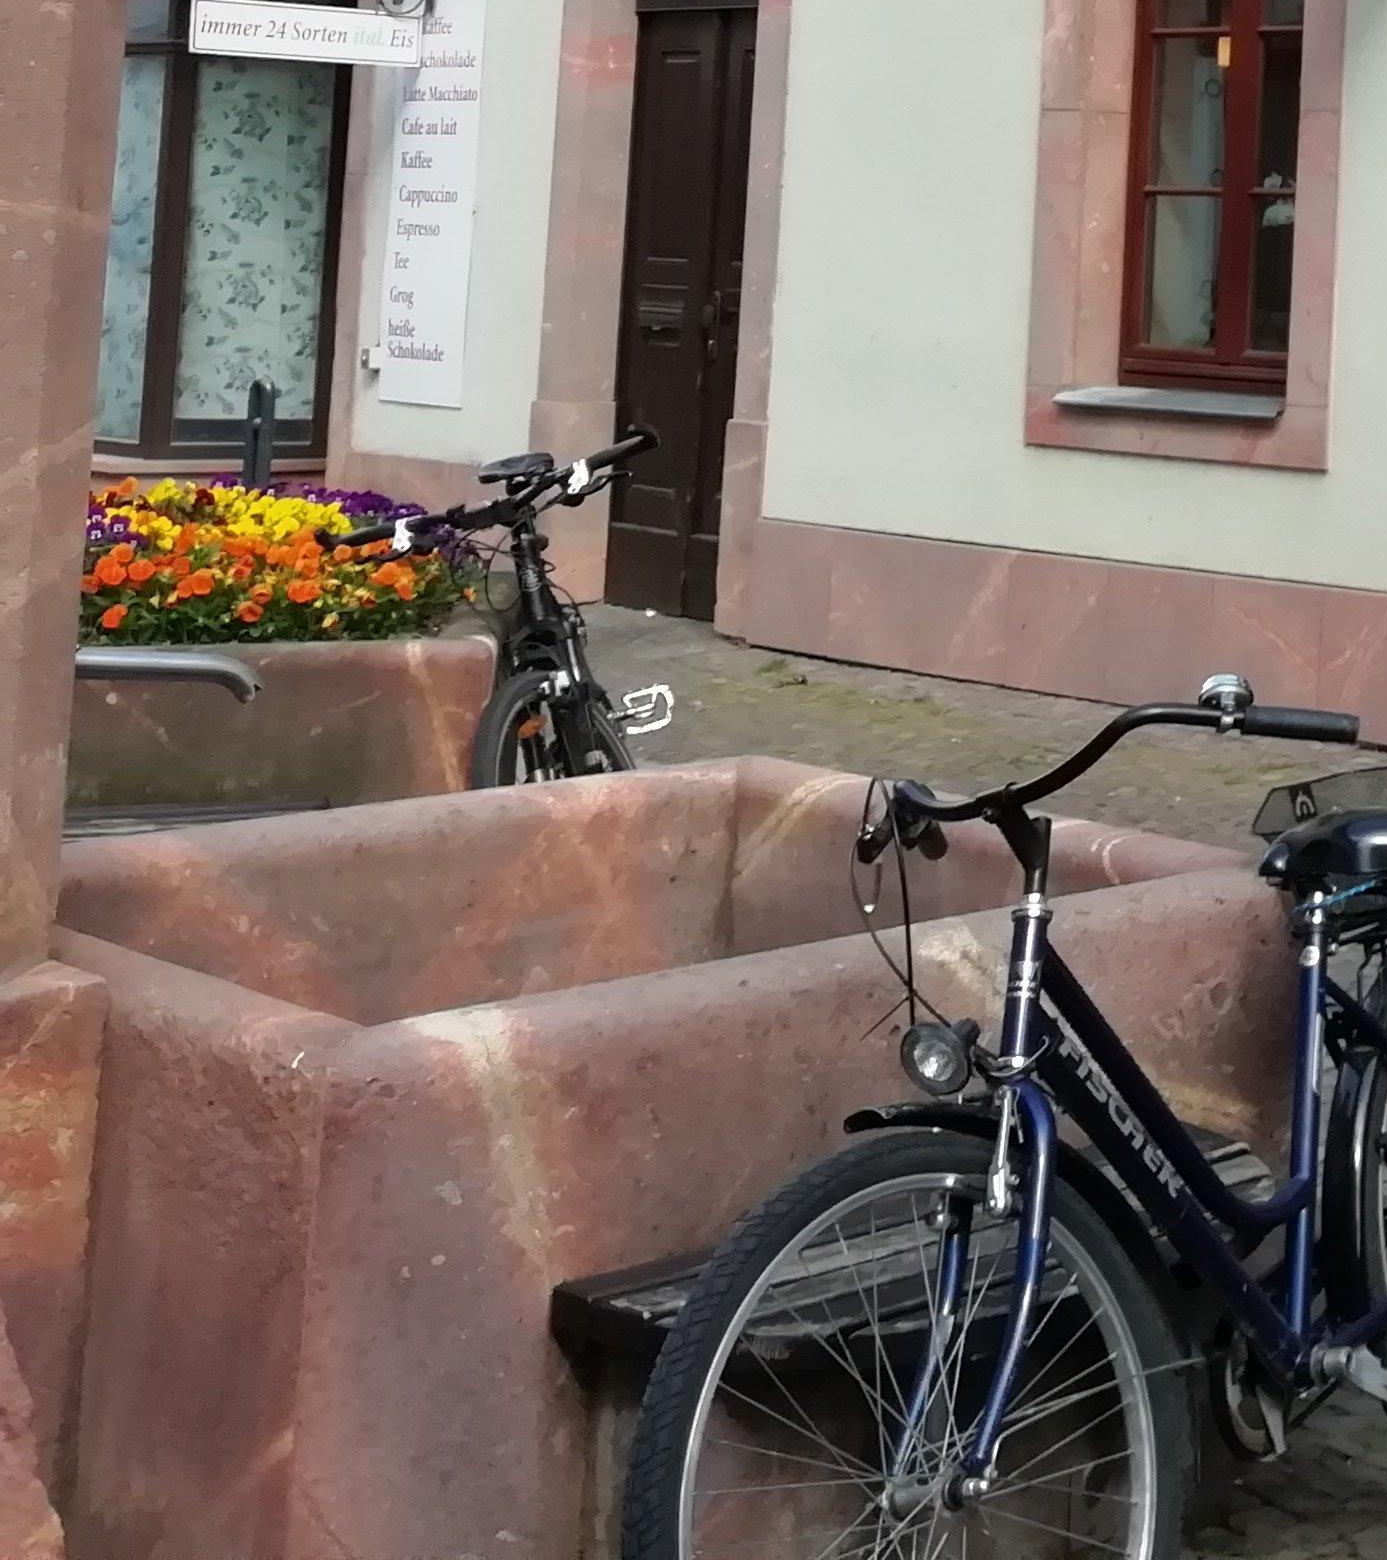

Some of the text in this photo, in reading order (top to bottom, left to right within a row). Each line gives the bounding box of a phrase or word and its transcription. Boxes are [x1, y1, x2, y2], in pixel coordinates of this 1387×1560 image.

[201, 14, 262, 38] immer
[265, 20, 286, 39] 24
[291, 21, 347, 44] Sorten
[389, 29, 414, 49] Eis
[403, 84, 478, 102] Latte Macchiato
[426, 123, 438, 135] au
[441, 117, 457, 135] lait
[400, 151, 433, 169] Kaffee
[399, 185, 458, 208] Cappuccino
[396, 218, 441, 241] Espresso
[394, 252, 410, 269] Tee
[390, 285, 414, 309] Grog
[388, 318, 416, 338] heiße
[388, 340, 445, 362] Schokolade
[1059, 1037, 1184, 1200] FISCHER
